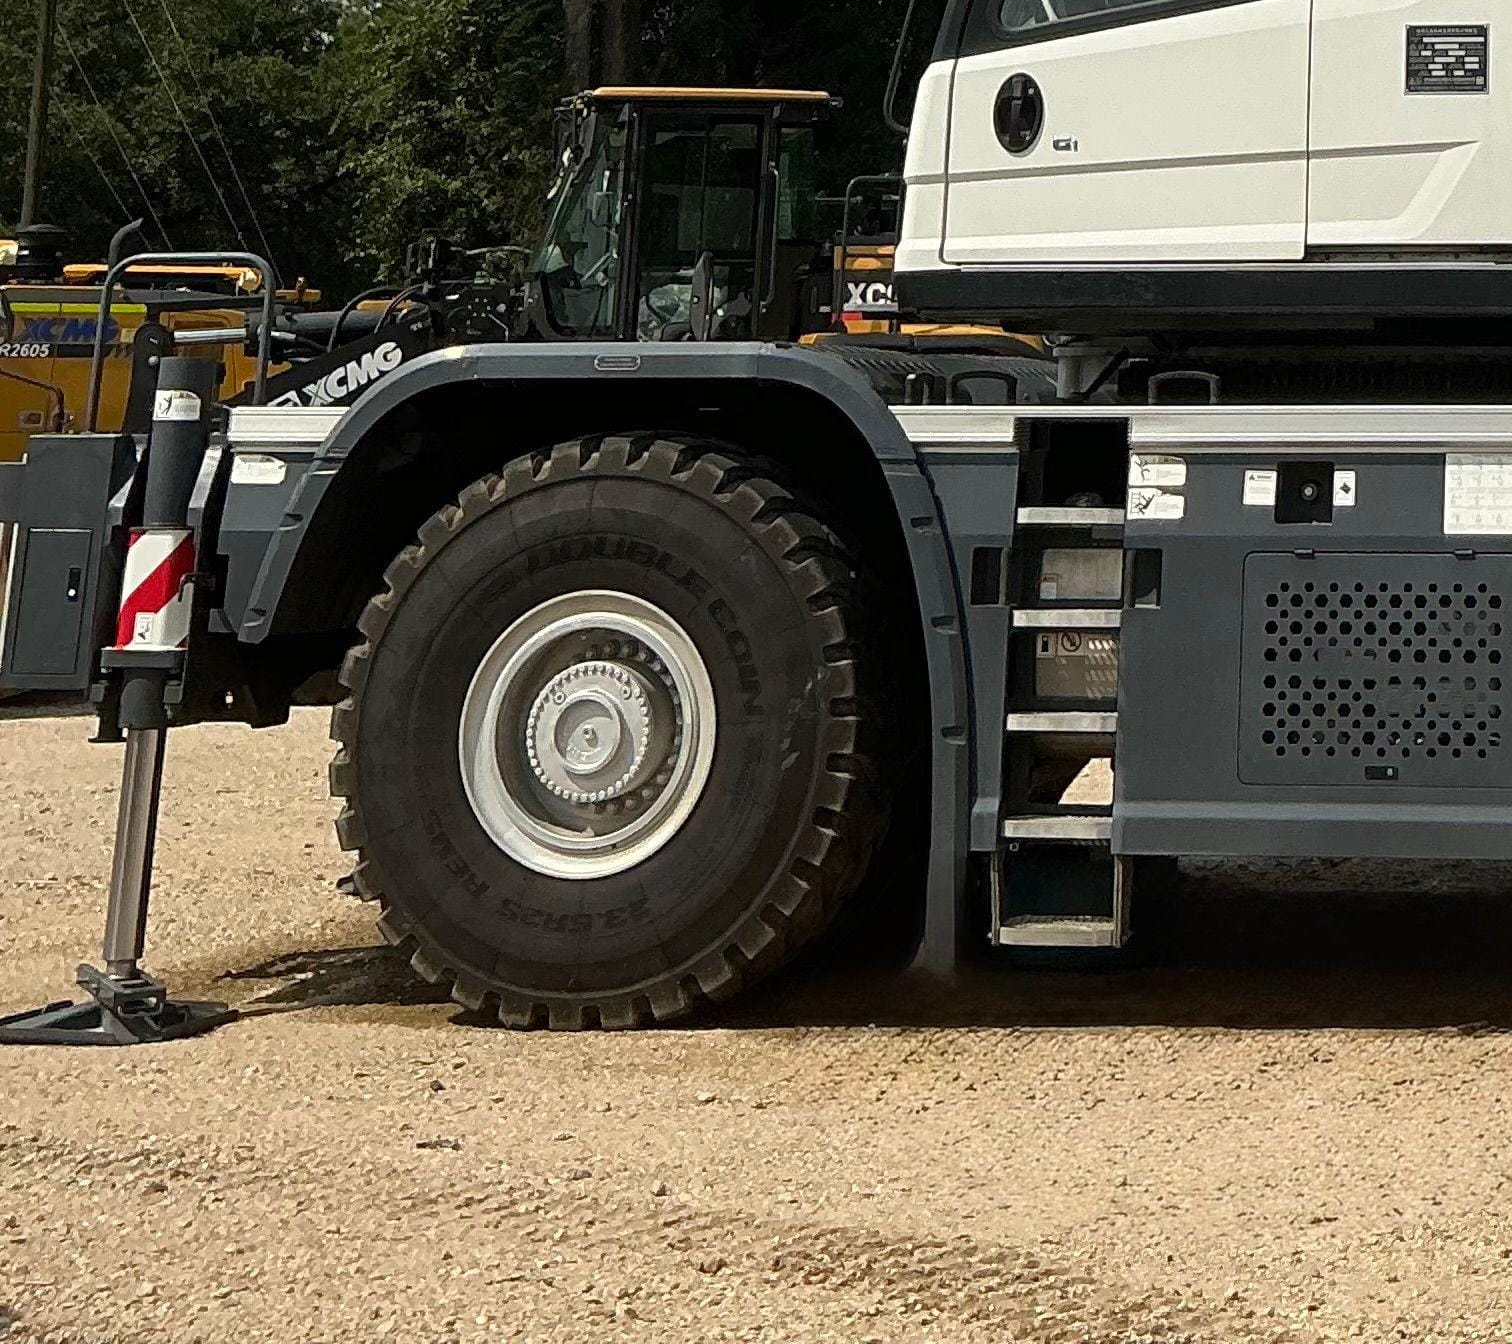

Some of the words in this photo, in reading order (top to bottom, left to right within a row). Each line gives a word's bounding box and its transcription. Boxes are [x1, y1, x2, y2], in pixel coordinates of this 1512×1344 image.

[302, 341, 403, 407] XCMG
[527, 535, 713, 596] DOUBLE
[707, 597, 764, 715] COIN
